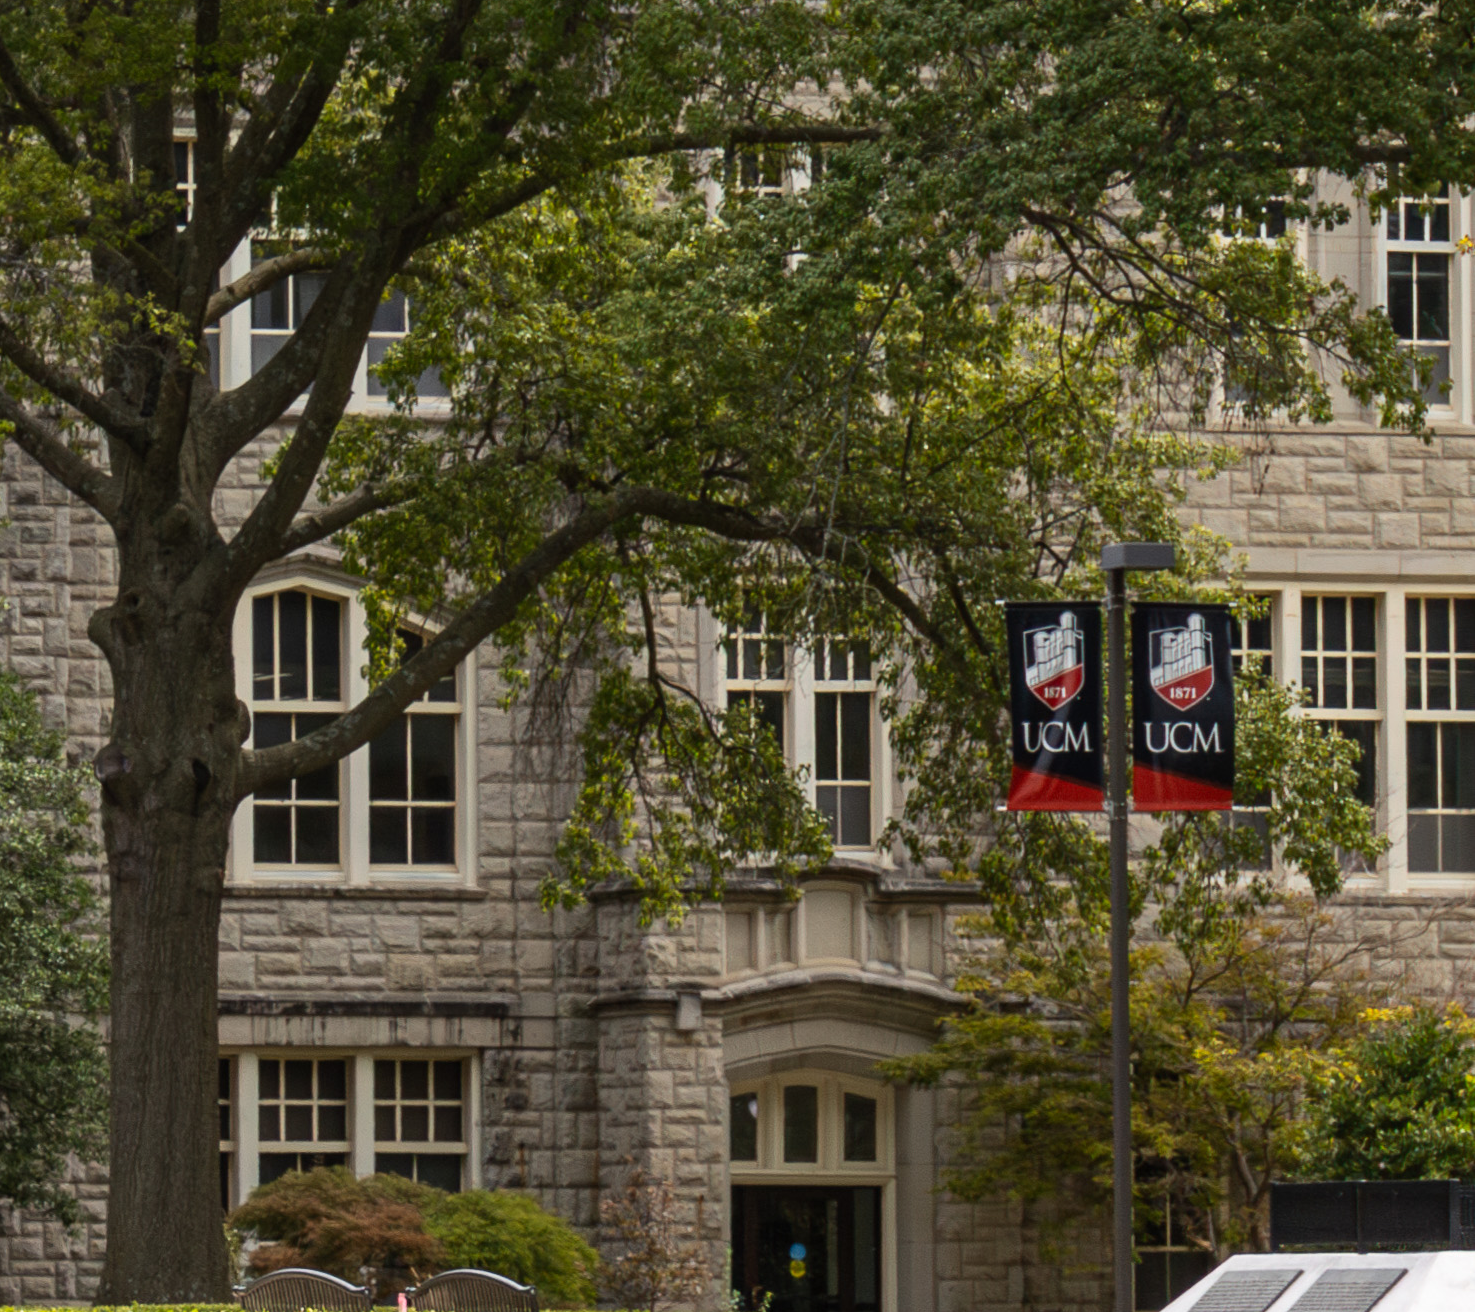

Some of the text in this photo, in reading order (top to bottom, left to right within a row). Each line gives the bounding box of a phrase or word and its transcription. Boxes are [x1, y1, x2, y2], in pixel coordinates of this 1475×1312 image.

[1043, 686, 1067, 699] 1871
[1168, 686, 1197, 699] 1871
[1022, 721, 1094, 753] UCM
[1144, 721, 1225, 753] UCM
